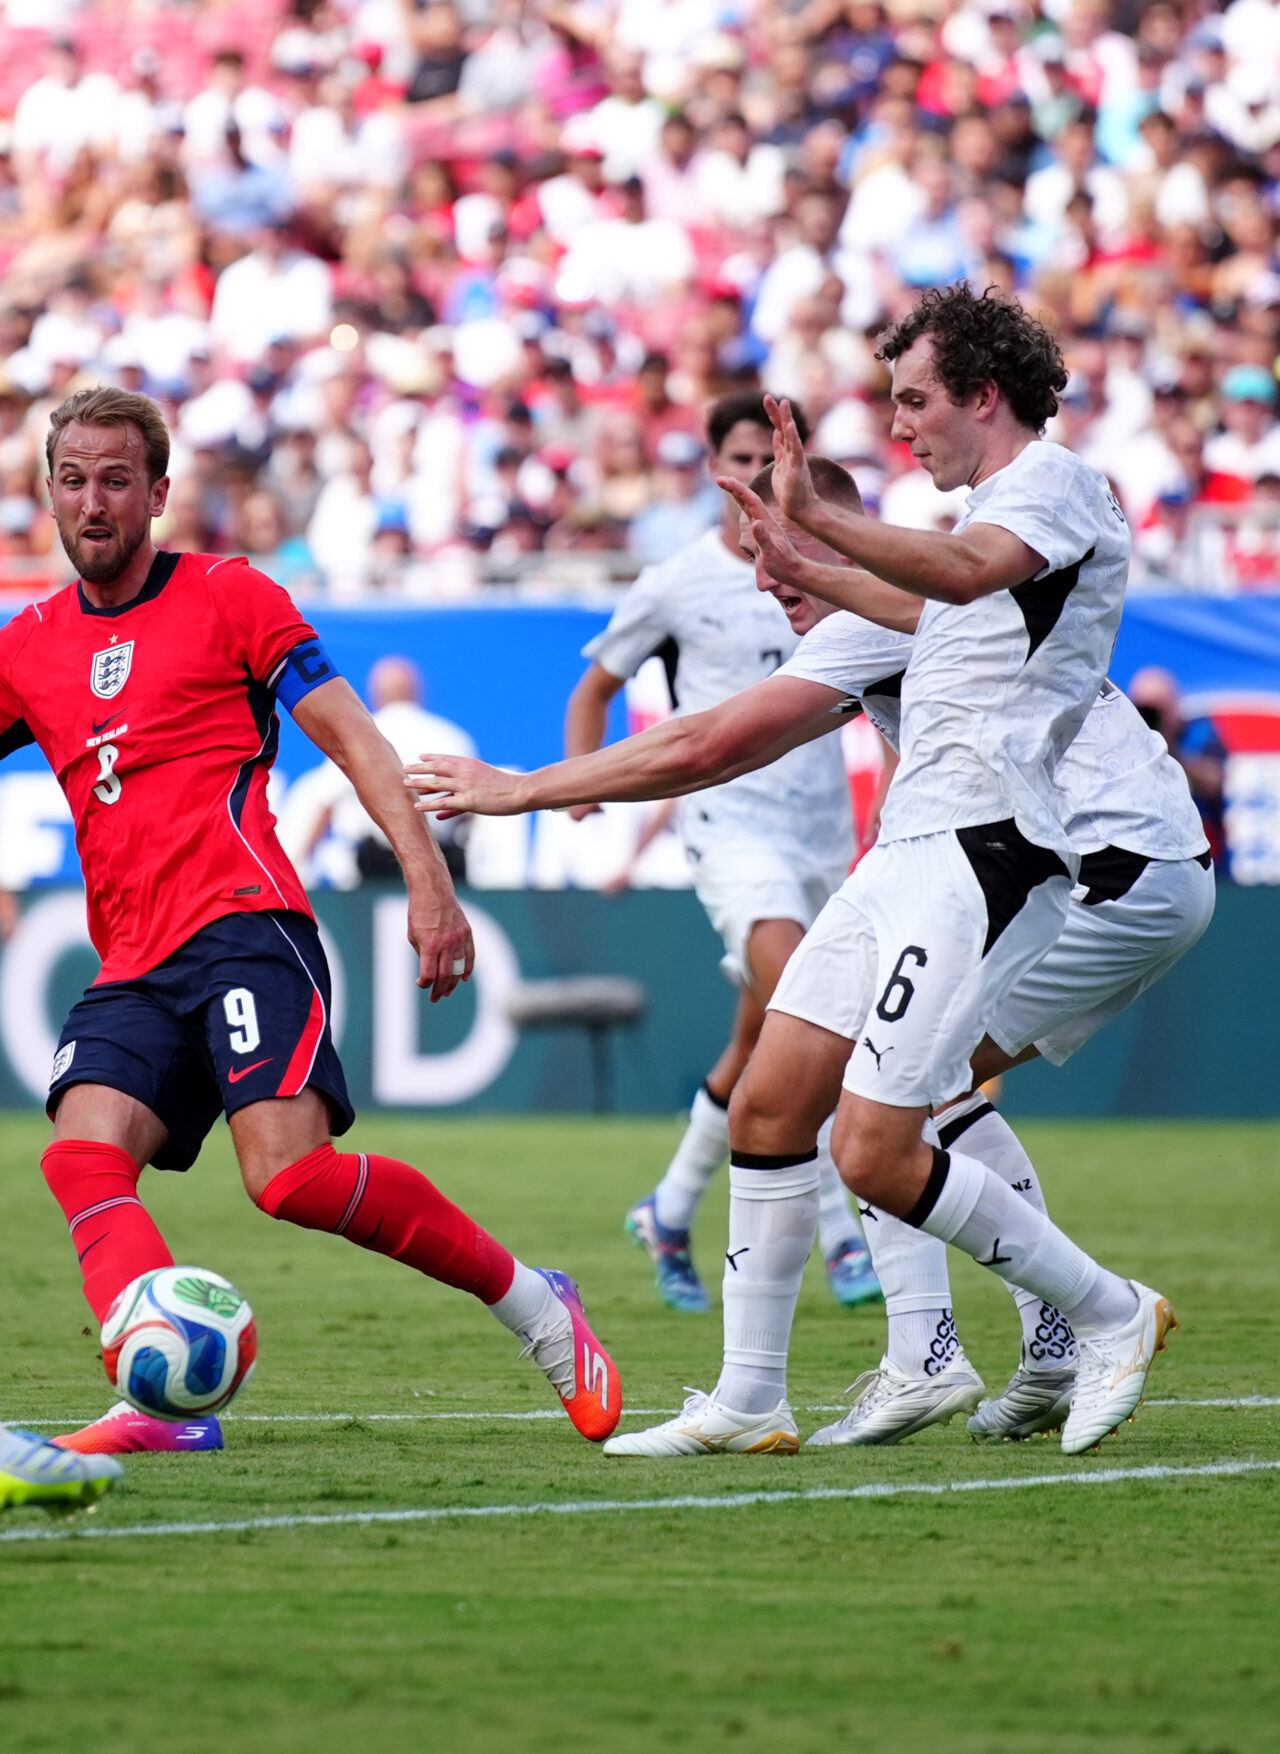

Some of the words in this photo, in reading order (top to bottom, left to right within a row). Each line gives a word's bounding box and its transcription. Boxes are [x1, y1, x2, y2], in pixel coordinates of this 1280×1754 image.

[292, 646, 330, 684] C
[876, 945, 928, 1023] 6
[223, 988, 261, 1054] 9
[1011, 1178, 1033, 1192] NZ
